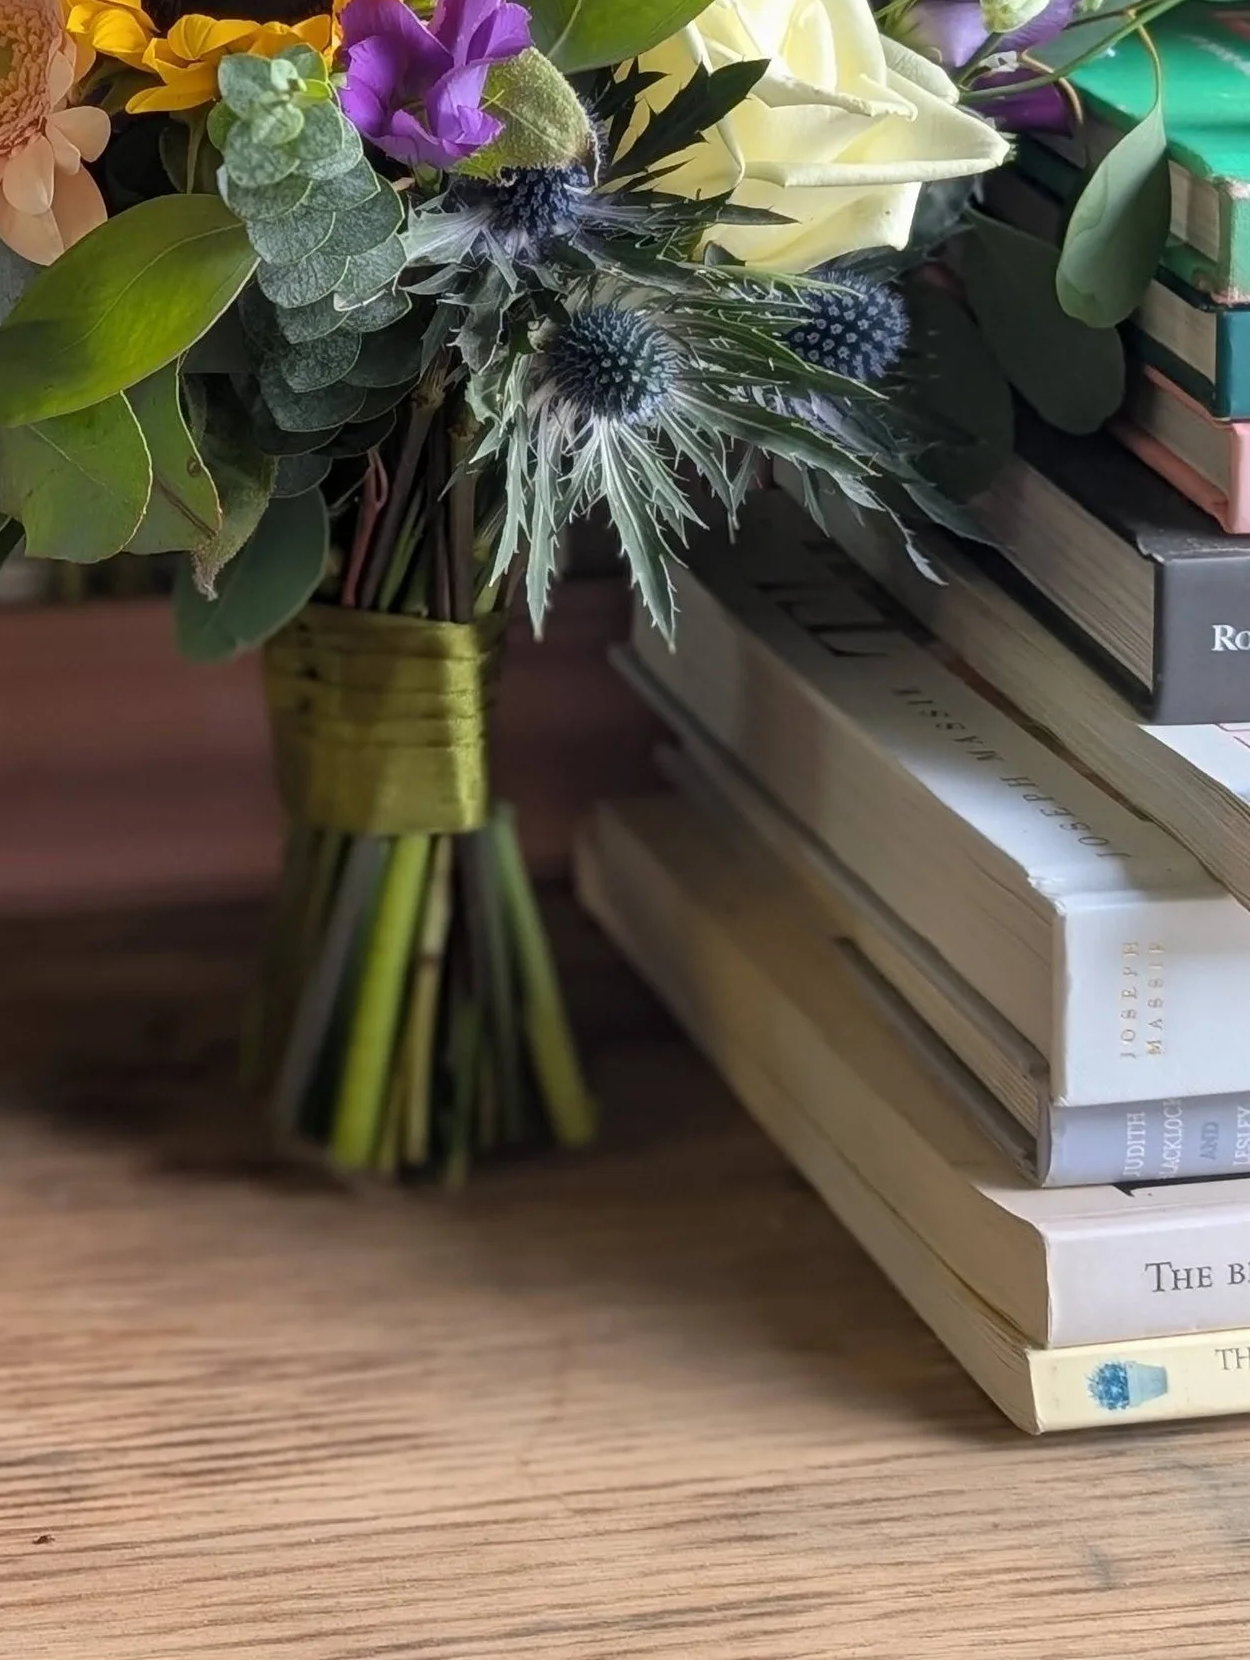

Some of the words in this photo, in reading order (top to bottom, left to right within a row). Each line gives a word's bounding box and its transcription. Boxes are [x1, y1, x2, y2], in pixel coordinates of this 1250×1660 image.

[1000, 776, 1132, 858] JOSEPH
[1120, 942, 1139, 1059] JOSEPH
[1124, 1112, 1146, 1177] JUDITH
[1199, 1121, 1219, 1160] AND
